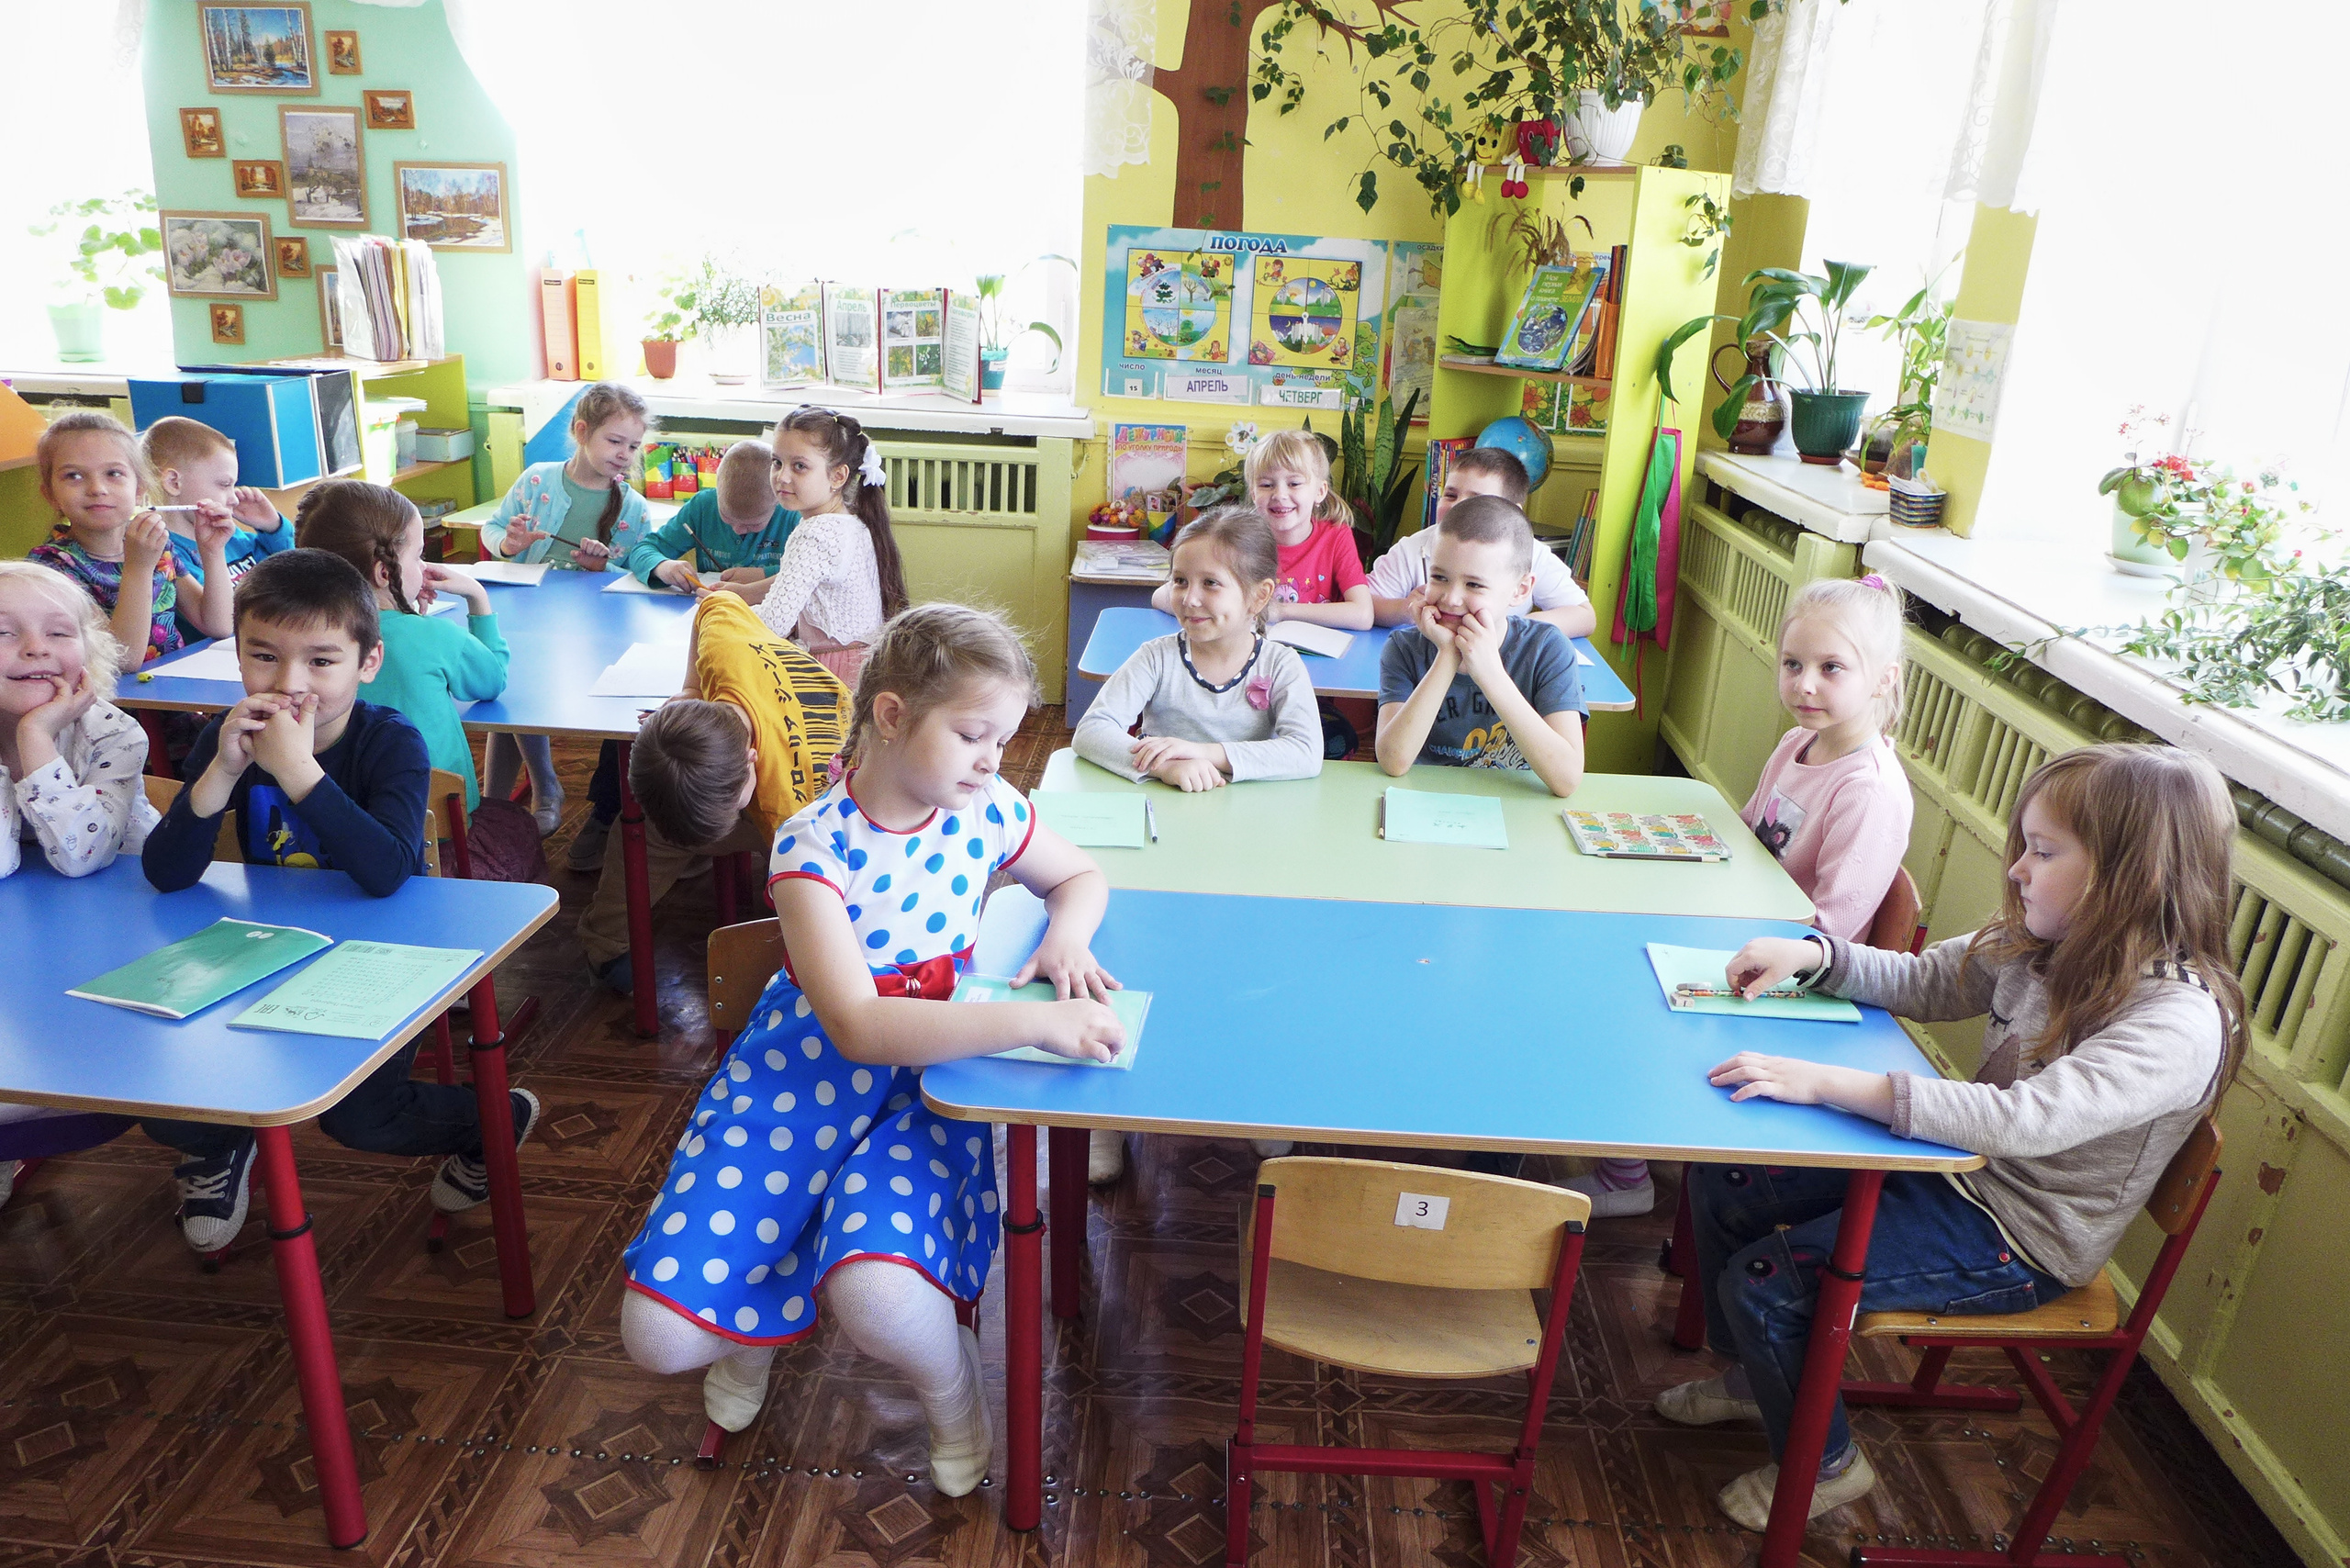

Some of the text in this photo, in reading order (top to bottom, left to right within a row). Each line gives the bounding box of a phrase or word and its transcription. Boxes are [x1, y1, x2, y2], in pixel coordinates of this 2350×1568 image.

[1209, 236, 1288, 254] ПОГОДА
[836, 300, 867, 313] Апрель
[890, 301, 936, 309] Первоцветы
[766, 312, 811, 323] Весна
[1119, 363, 1146, 371] число
[1195, 366, 1224, 375] месяц
[1186, 379, 1229, 393] АПРЕЛЬ
[1279, 389, 1323, 404] ЧЕТВЕРГ
[1118, 426, 1184, 444] ДЕЖУРНЫЙ
[1153, 444, 1184, 454] ПРИРОДЫ
[1415, 1201, 1429, 1217] 3
